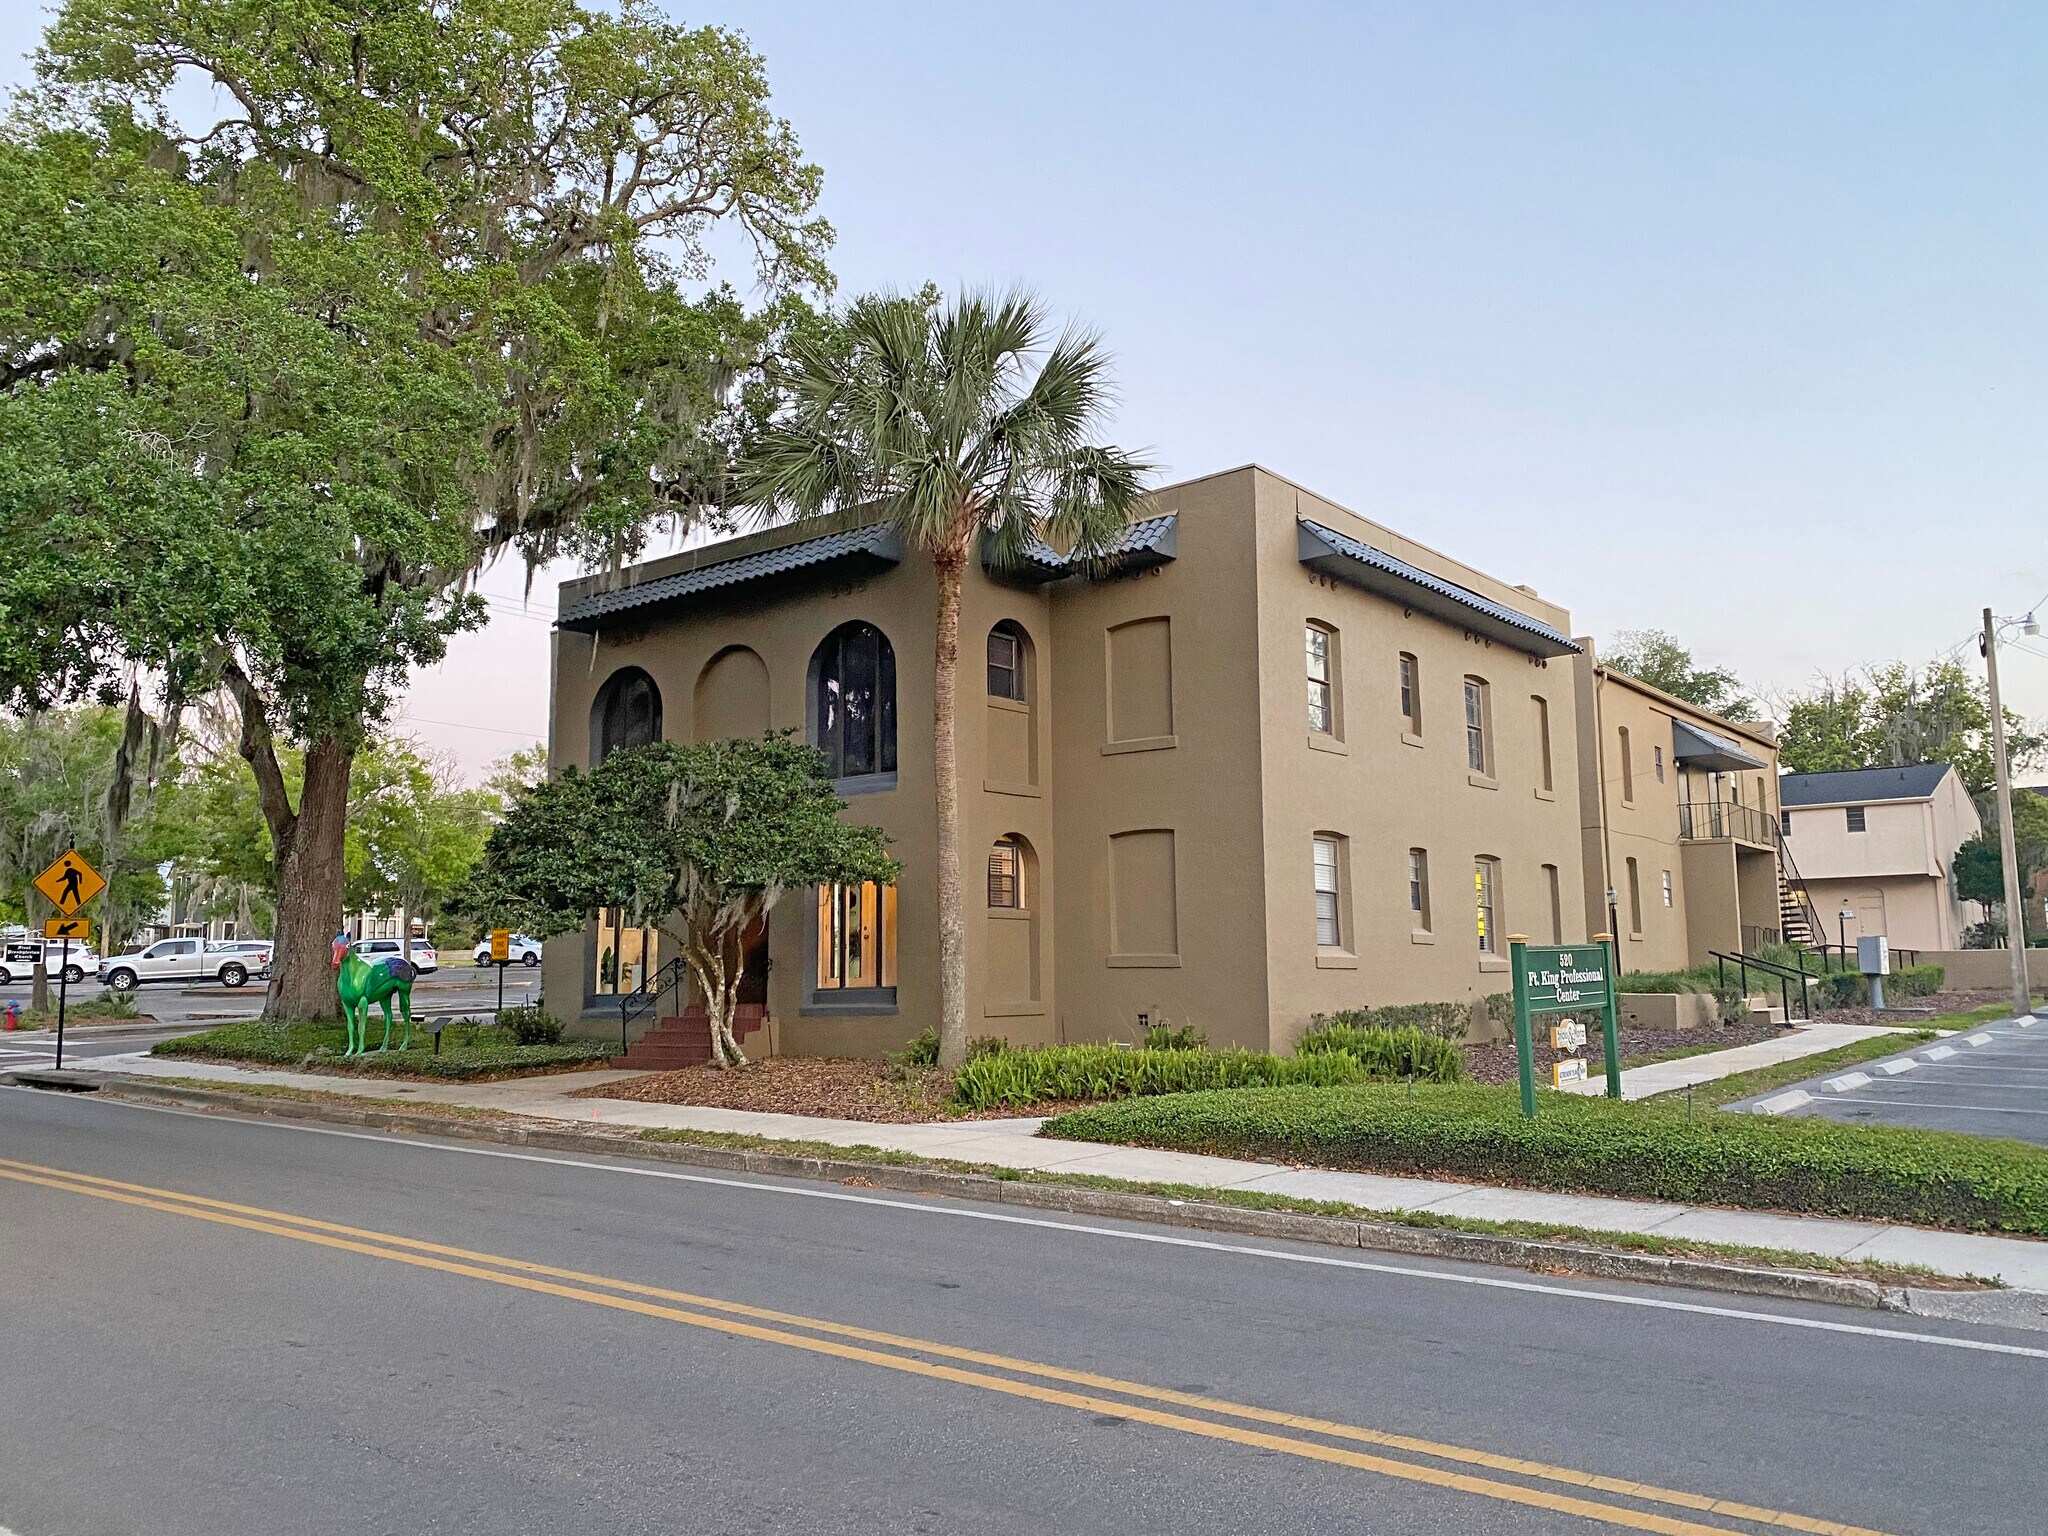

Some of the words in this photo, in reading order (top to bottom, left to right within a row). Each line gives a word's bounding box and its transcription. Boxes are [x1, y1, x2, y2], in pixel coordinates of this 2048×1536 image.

[1559, 953, 1573, 967] 520
[1528, 971, 1540, 987] Ft.
[1540, 970, 1560, 989] King
[1560, 967, 1604, 984] Professional
[1556, 987, 1580, 1003] Center
